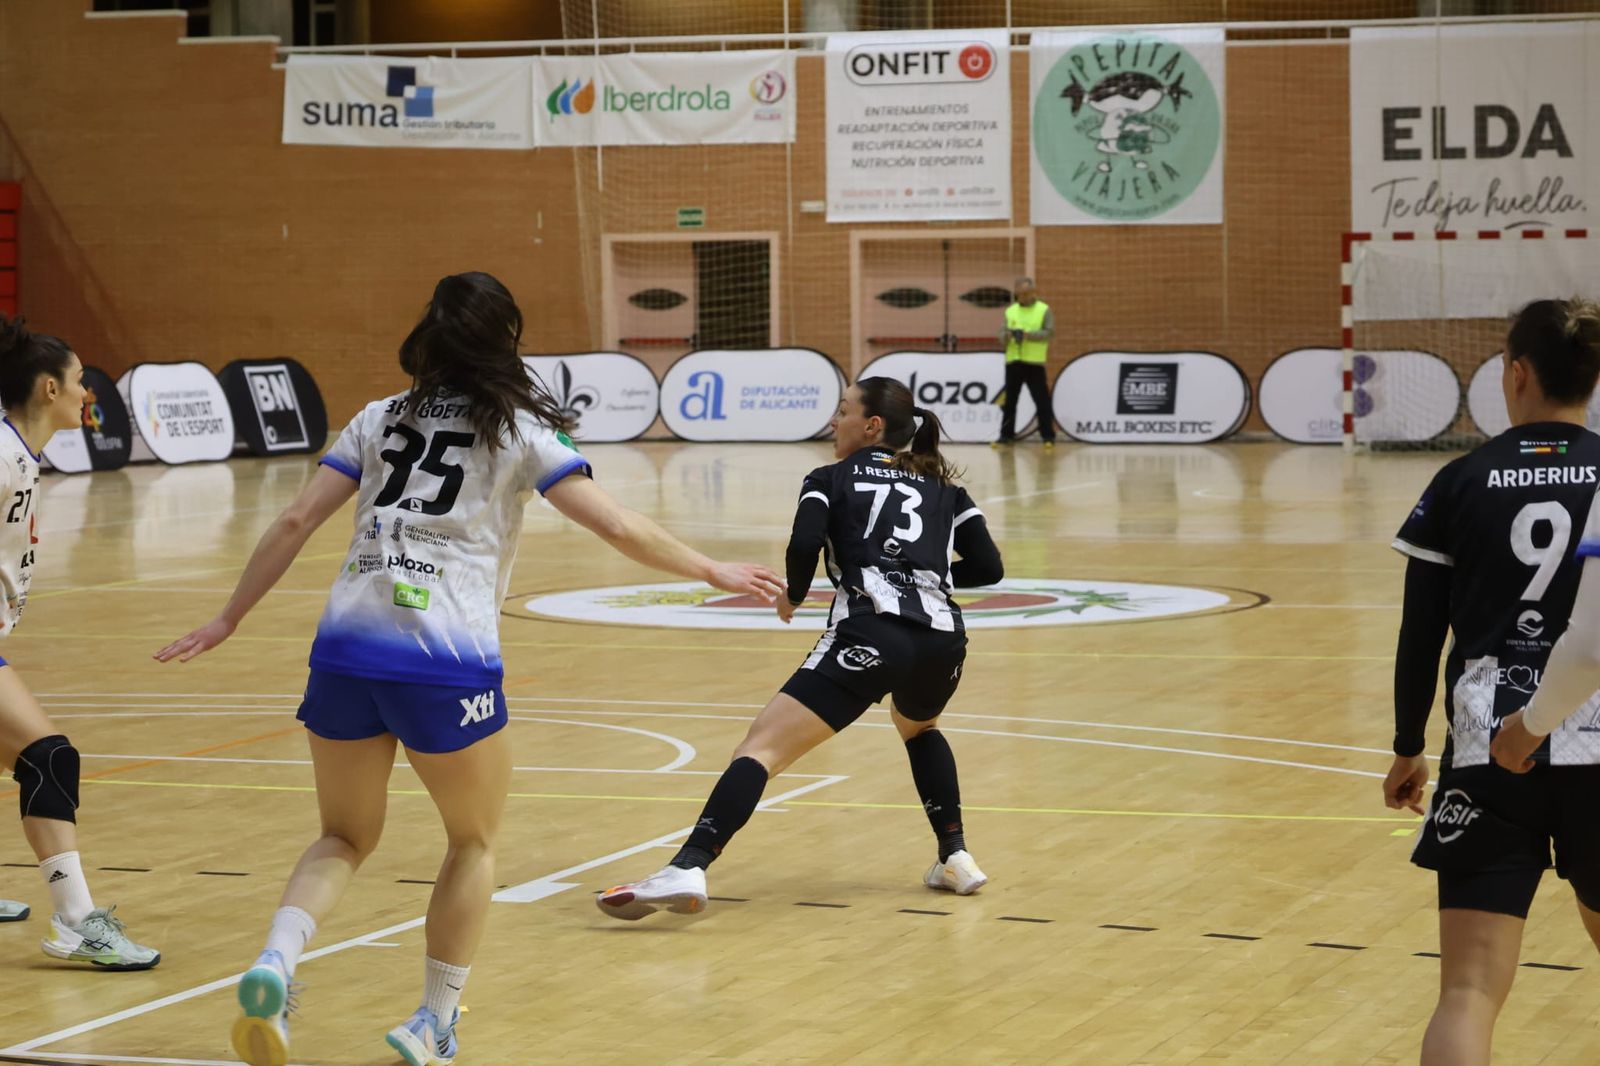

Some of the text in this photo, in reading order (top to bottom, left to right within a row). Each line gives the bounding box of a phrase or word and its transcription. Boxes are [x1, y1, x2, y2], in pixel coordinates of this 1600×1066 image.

[852, 51, 950, 77] ONFIT
[1071, 39, 1181, 82] PEPITA
[603, 84, 730, 112] Iberdrola
[302, 100, 399, 128] suma
[864, 104, 970, 117] ENTRENAMIENTOS
[932, 120, 998, 132] DEPORTIVA
[1382, 103, 1574, 161] ELDA
[919, 155, 985, 168] DEPORTIVA
[1071, 160, 1180, 201] VIAJERA
[1371, 176, 1419, 229] Te
[1413, 179, 1480, 231] deja
[251, 373, 295, 411] BN
[741, 385, 821, 397] DIPUTACIÓN
[909, 370, 988, 405] laza
[157, 401, 213, 420] COMUNITAT
[739, 398, 818, 410] DE ALICANTE
[166, 421, 181, 438] DE
[1075, 421, 1122, 434] MAIL
[1123, 420, 1176, 434] BOXES
[373, 423, 476, 516] 35
[852, 464, 863, 475] J.
[1486, 466, 1597, 488] ARDERIUS
[853, 481, 924, 543] 73
[404, 524, 450, 542] GENERALITAT
[404, 531, 448, 548] VALENCIANA
[1510, 500, 1573, 602] 9
[387, 552, 435, 574] plaza
